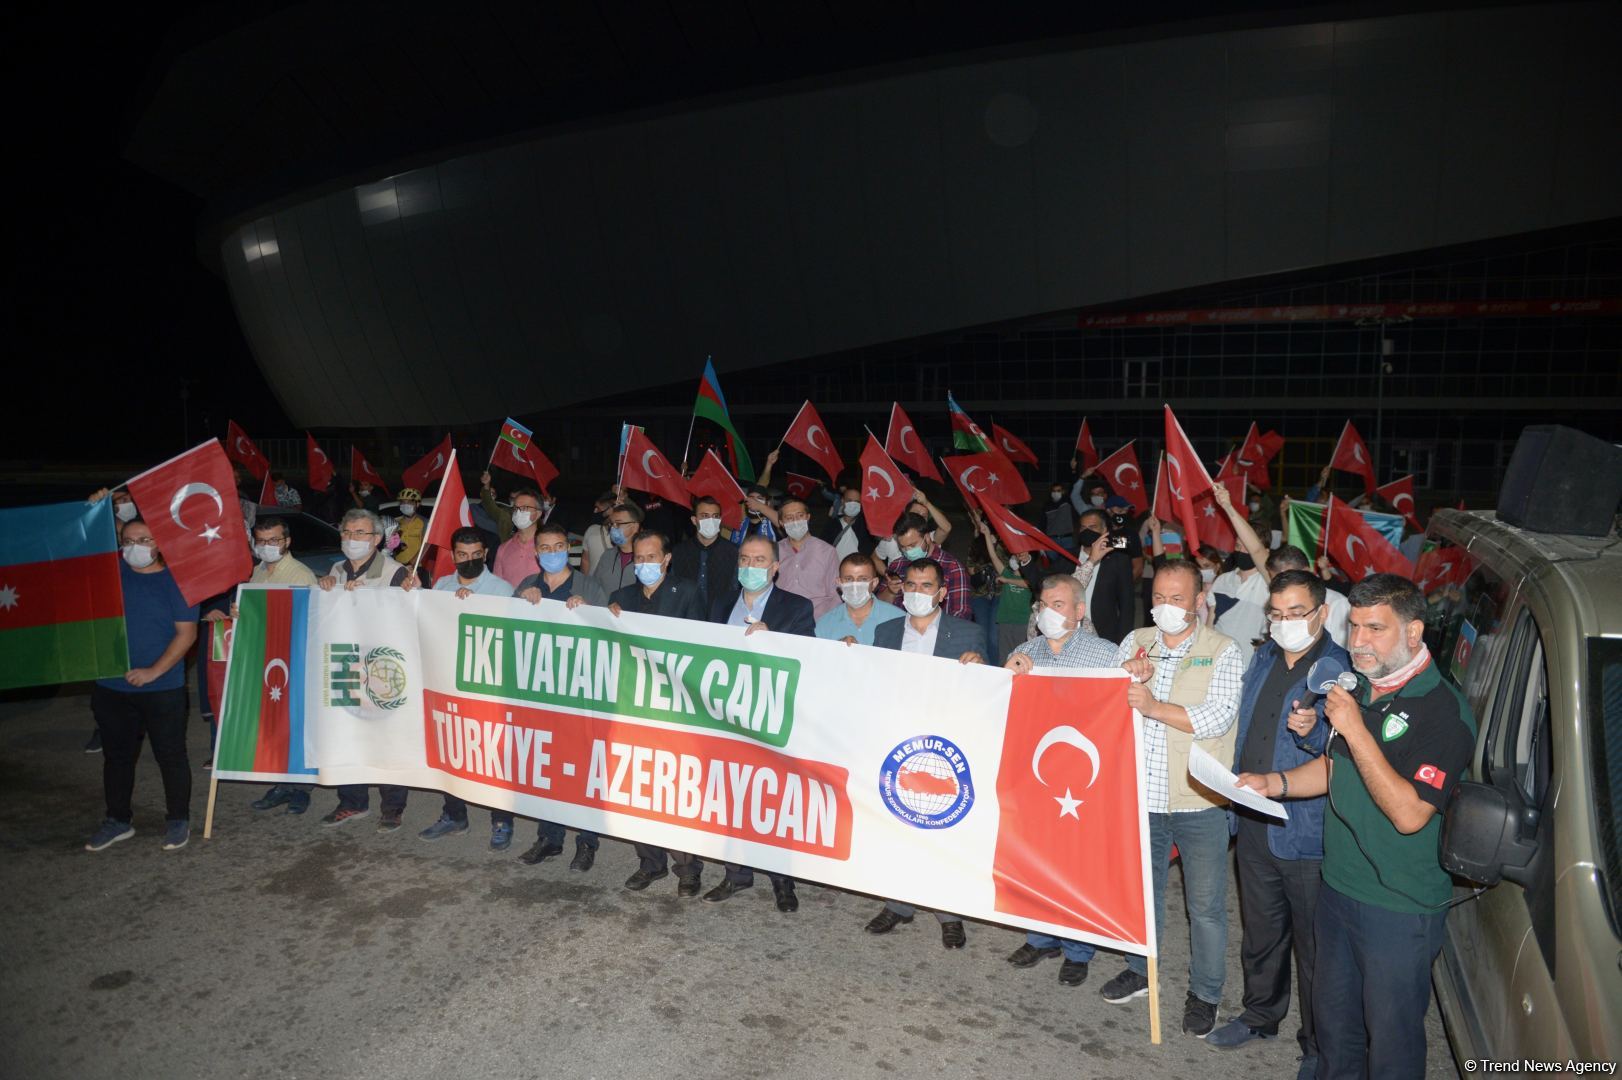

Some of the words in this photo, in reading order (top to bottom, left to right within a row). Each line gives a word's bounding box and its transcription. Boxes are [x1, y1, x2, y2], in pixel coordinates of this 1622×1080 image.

[514, 631, 620, 703] VATAN
[630, 646, 696, 714] TEK
[700, 659, 789, 735] CAN
[432, 702, 552, 790] TÜRKİYE
[563, 763, 575, 776] -
[586, 739, 837, 848] AZERBAYCAN
[892, 739, 966, 774] MEMUR-SEN
[925, 784, 970, 826] KONFEDERASYONU
